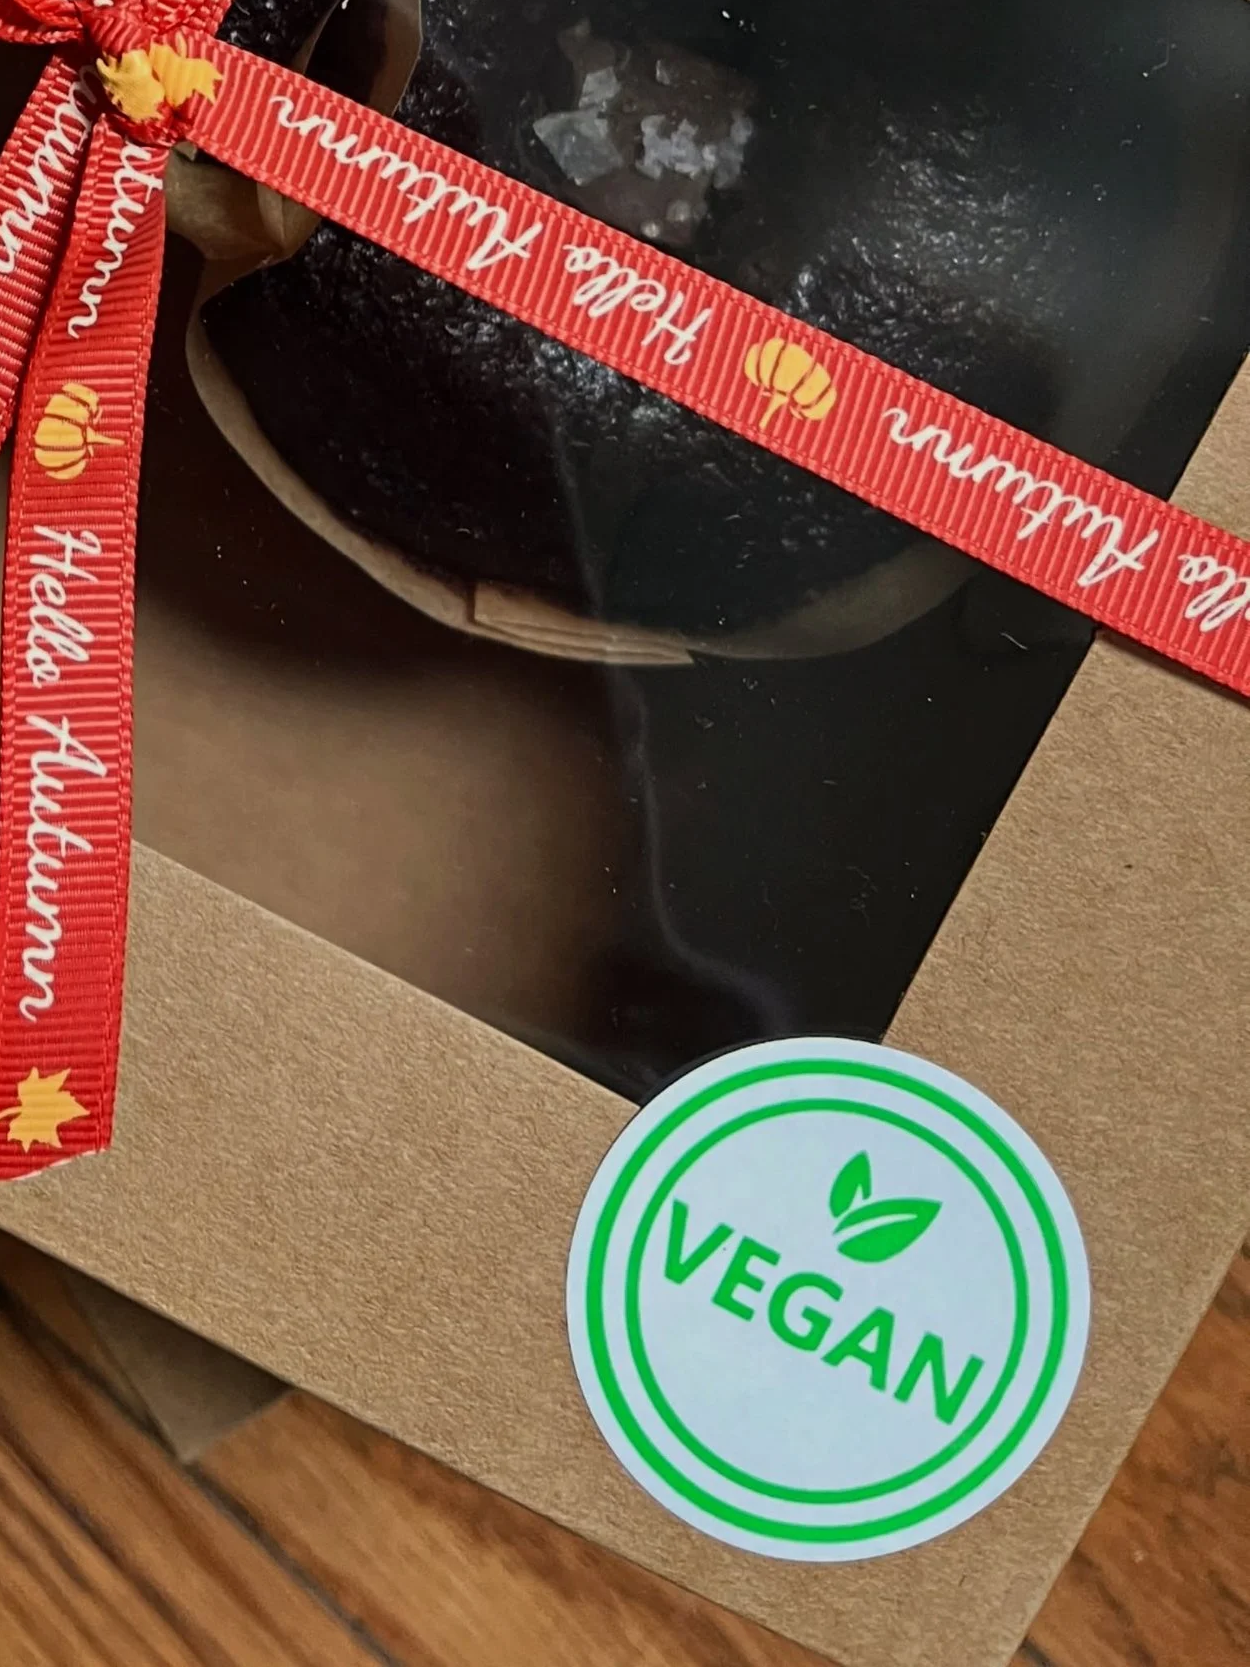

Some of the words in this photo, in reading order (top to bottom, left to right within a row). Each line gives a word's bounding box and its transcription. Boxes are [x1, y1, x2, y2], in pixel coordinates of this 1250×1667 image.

[269, 95, 544, 272] Autumn
[563, 244, 714, 366] Hello
[882, 407, 1160, 587] Autumn
[27, 523, 103, 689] Hello
[23, 713, 107, 1025] Autumn
[664, 1197, 985, 1426] VEGAN
